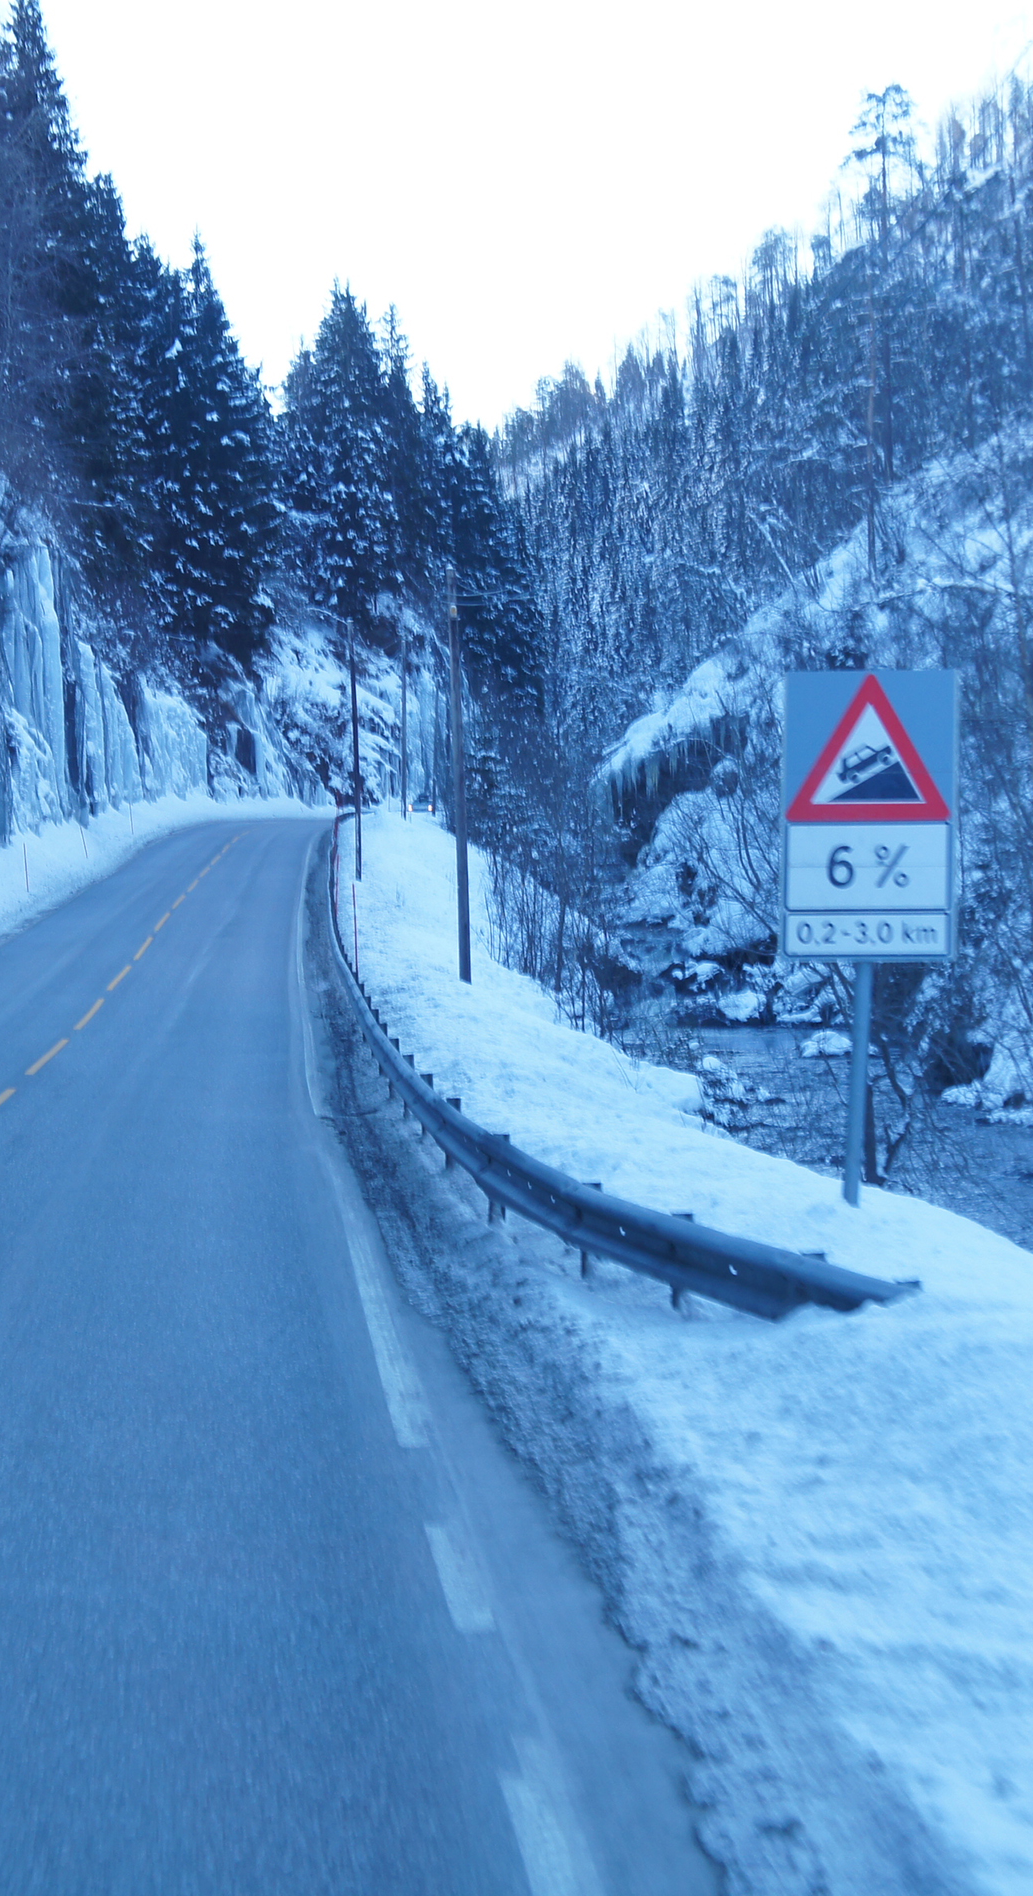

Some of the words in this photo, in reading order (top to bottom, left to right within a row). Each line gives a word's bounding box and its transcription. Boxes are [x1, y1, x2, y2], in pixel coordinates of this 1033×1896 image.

[828, 845, 855, 888] 6
[875, 843, 910, 888] %
[901, 920, 939, 944] km
